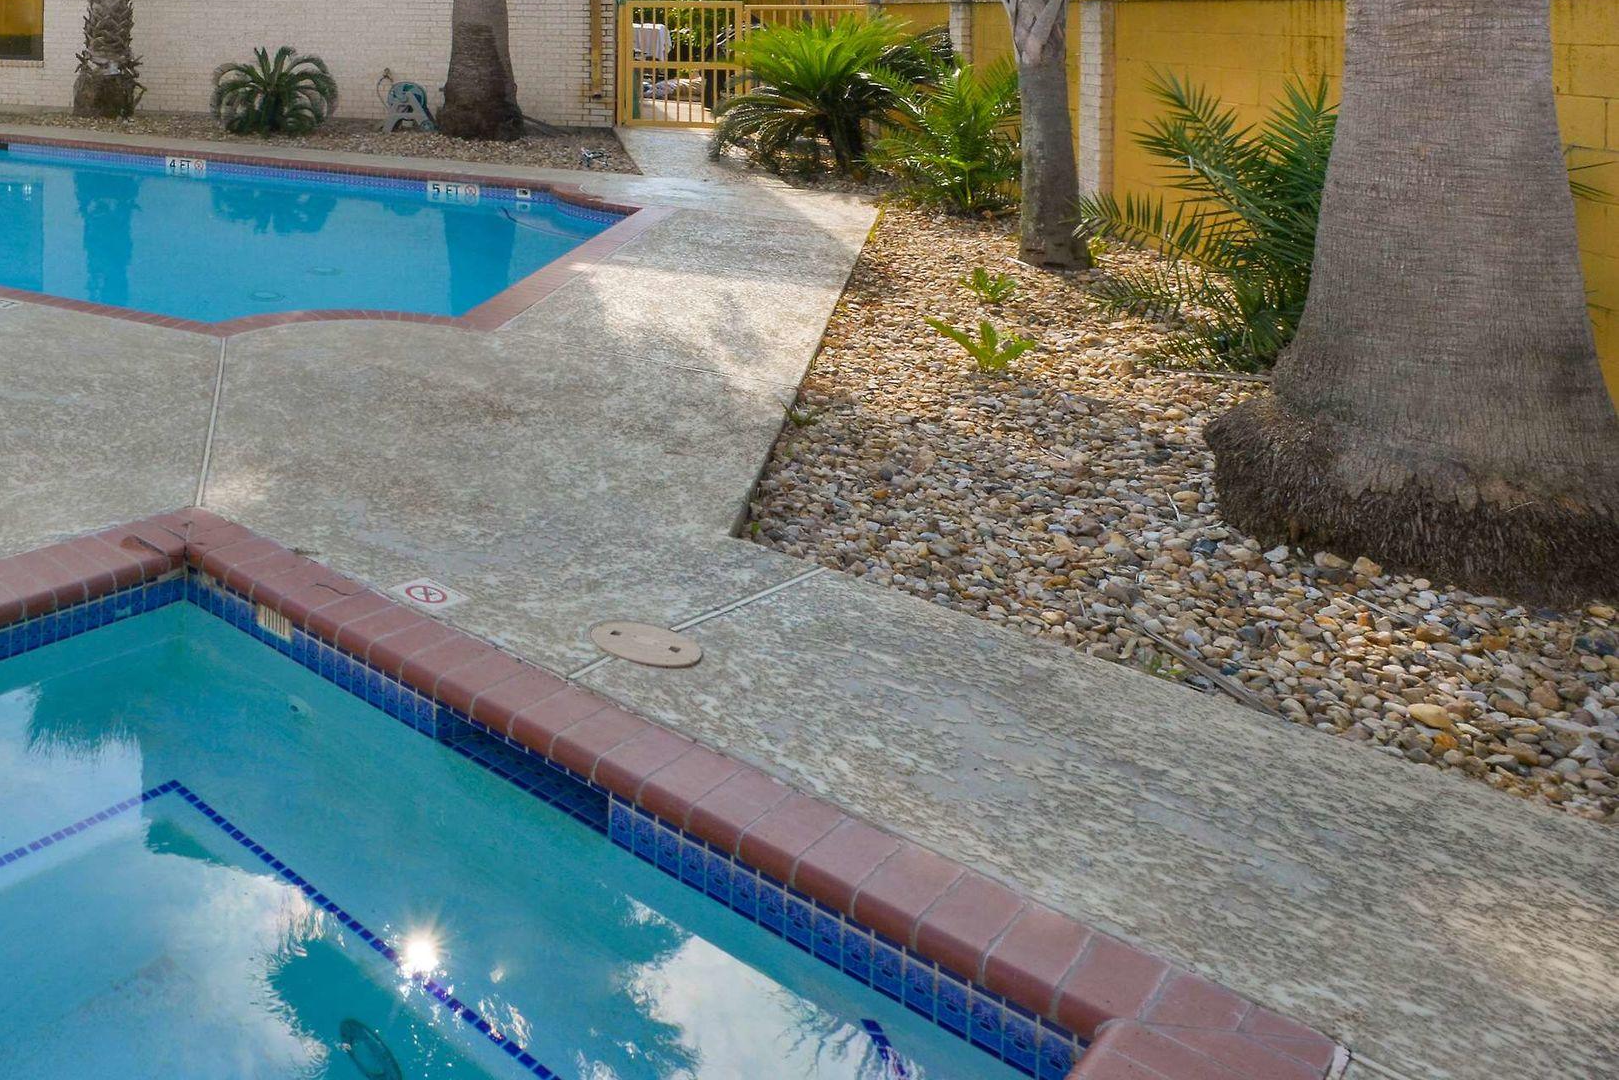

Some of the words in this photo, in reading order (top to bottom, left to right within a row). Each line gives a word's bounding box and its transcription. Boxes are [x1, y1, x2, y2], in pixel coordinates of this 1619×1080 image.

[169, 158, 176, 168] 4
[180, 159, 191, 169] FT
[432, 183, 441, 193] 5
[445, 184, 461, 195] FT
